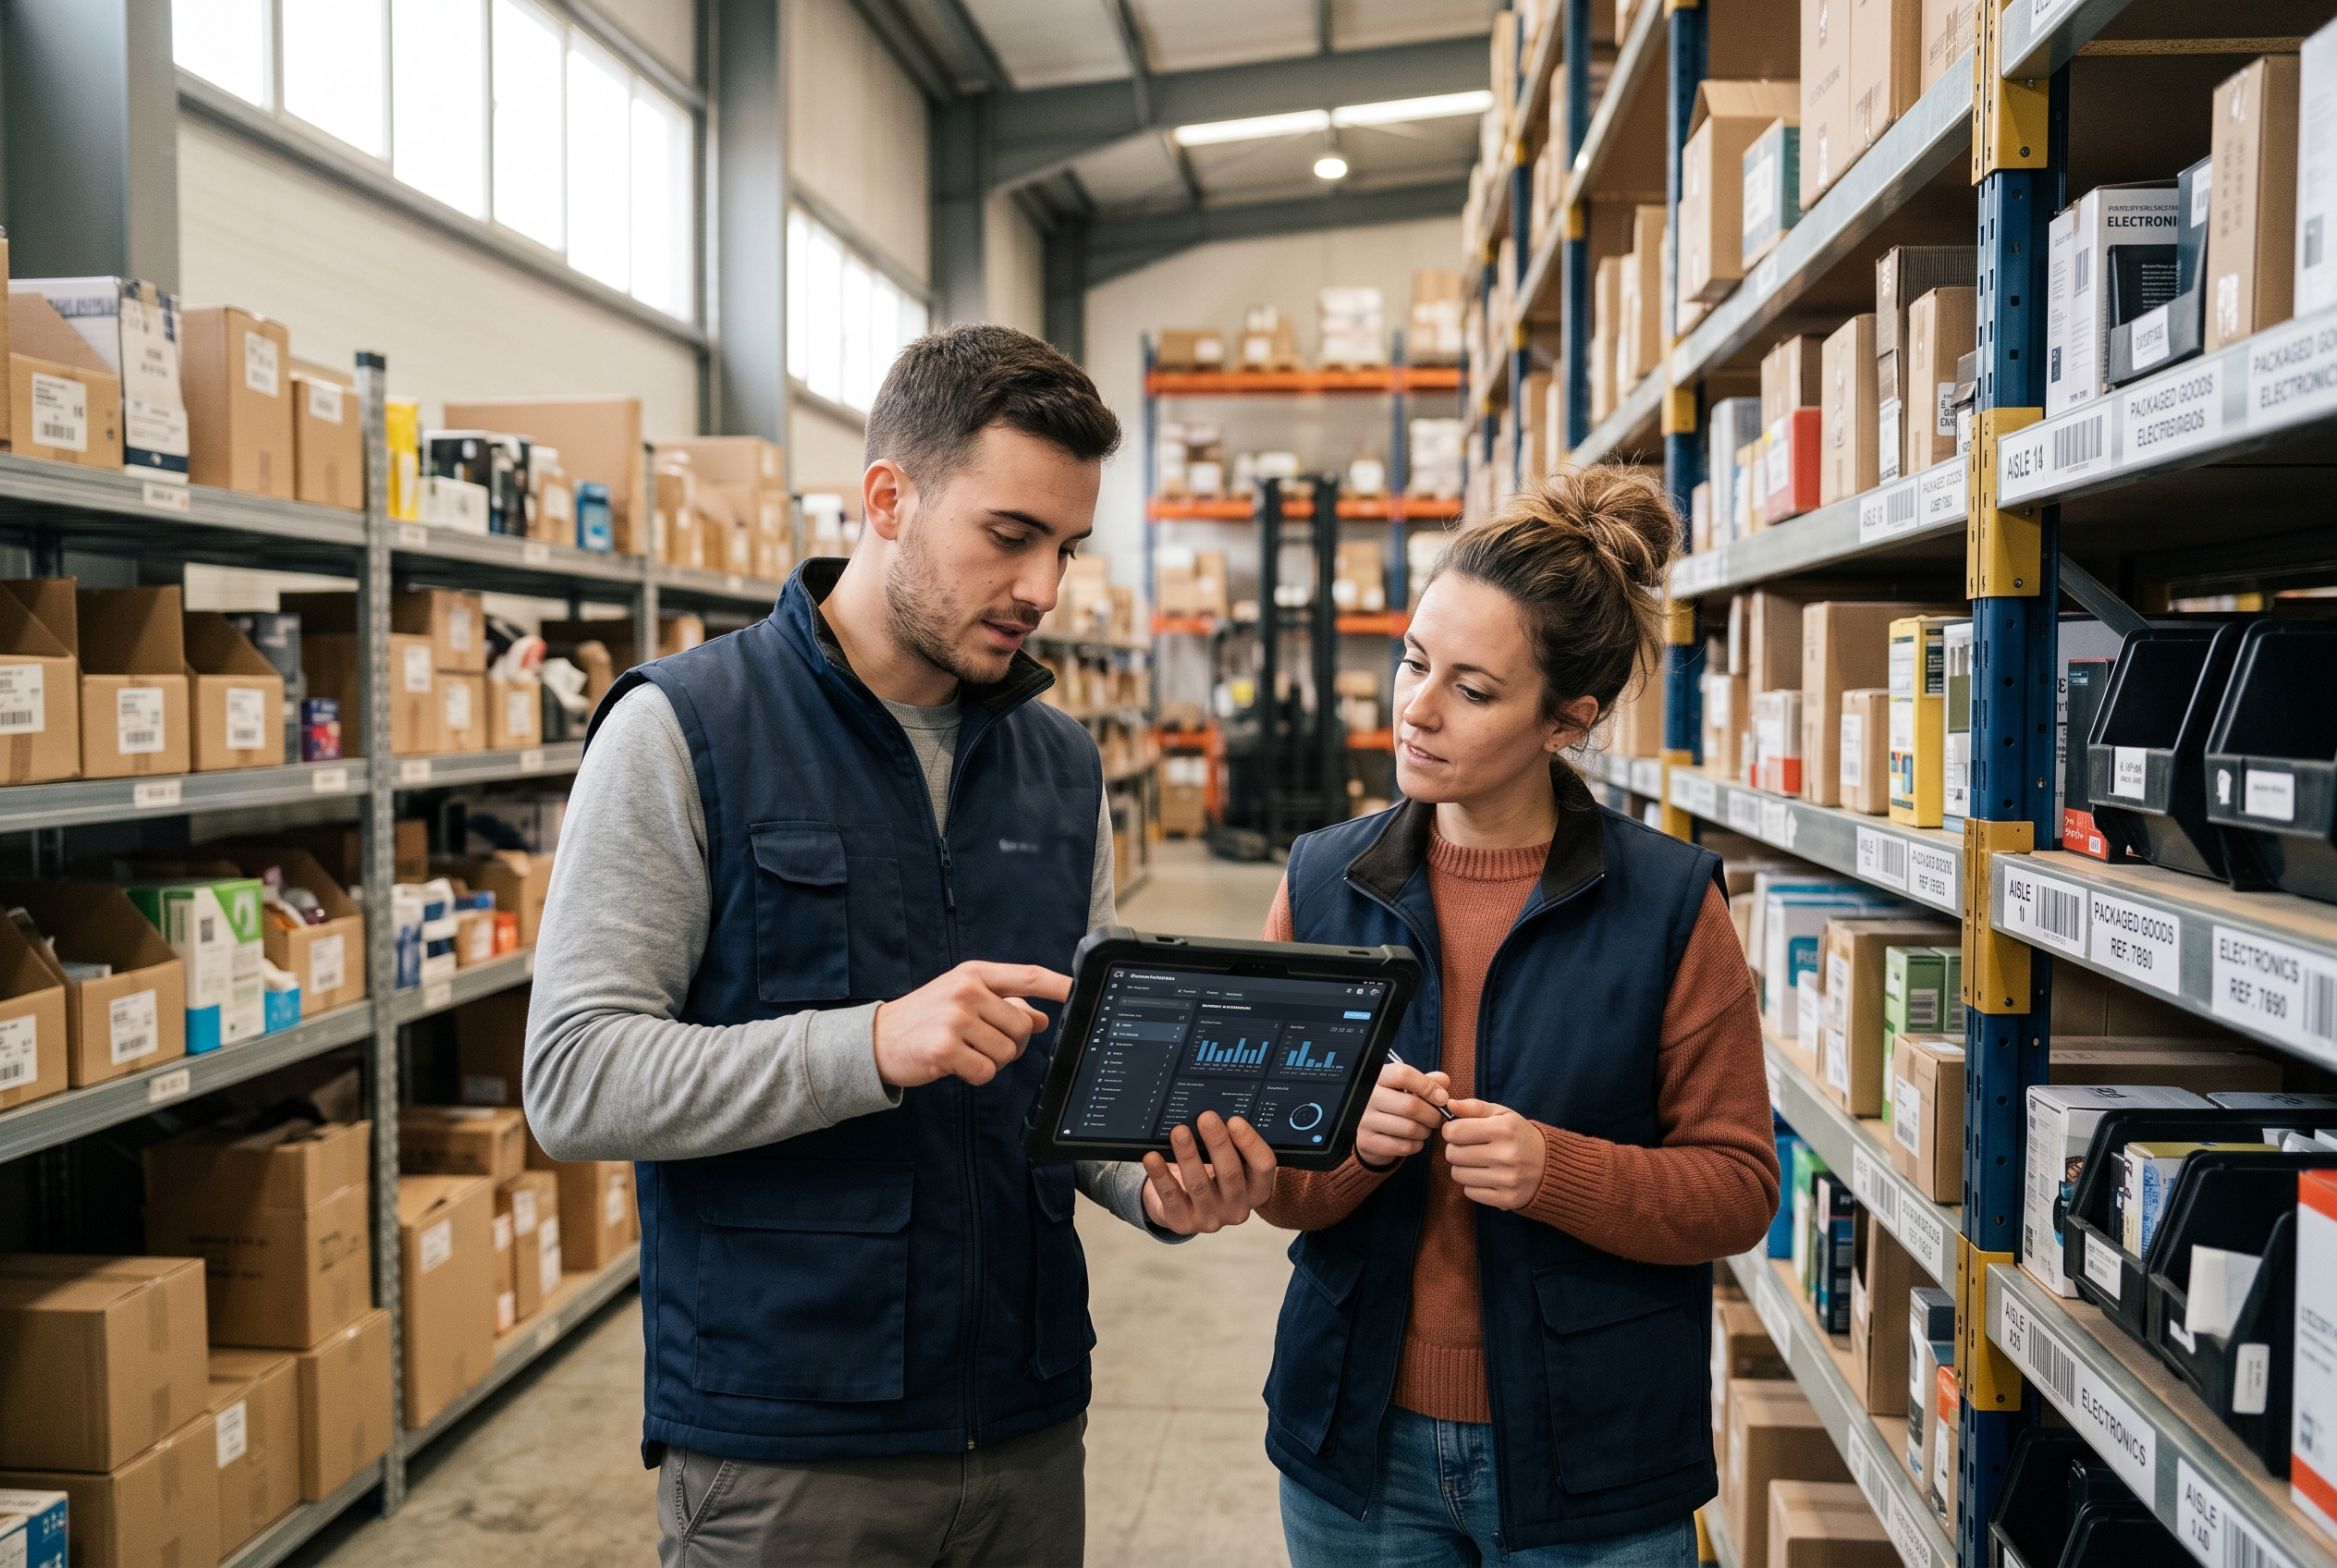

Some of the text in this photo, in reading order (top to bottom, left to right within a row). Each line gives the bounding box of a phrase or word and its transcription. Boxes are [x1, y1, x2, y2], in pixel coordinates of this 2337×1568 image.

[2130, 373, 2214, 422] PACKAGED GOODS
[2006, 448, 2031, 481] AISLE
[2009, 879, 2031, 902] AISLE
[2095, 900, 2174, 946] PACKAGED GOODS
[2221, 937, 2299, 983] ELECTRONICS
[2005, 1302, 2025, 1333] AISLE
[2081, 1386, 2147, 1467] ELECTRONICS
[2185, 1481, 2218, 1530] AISLE
